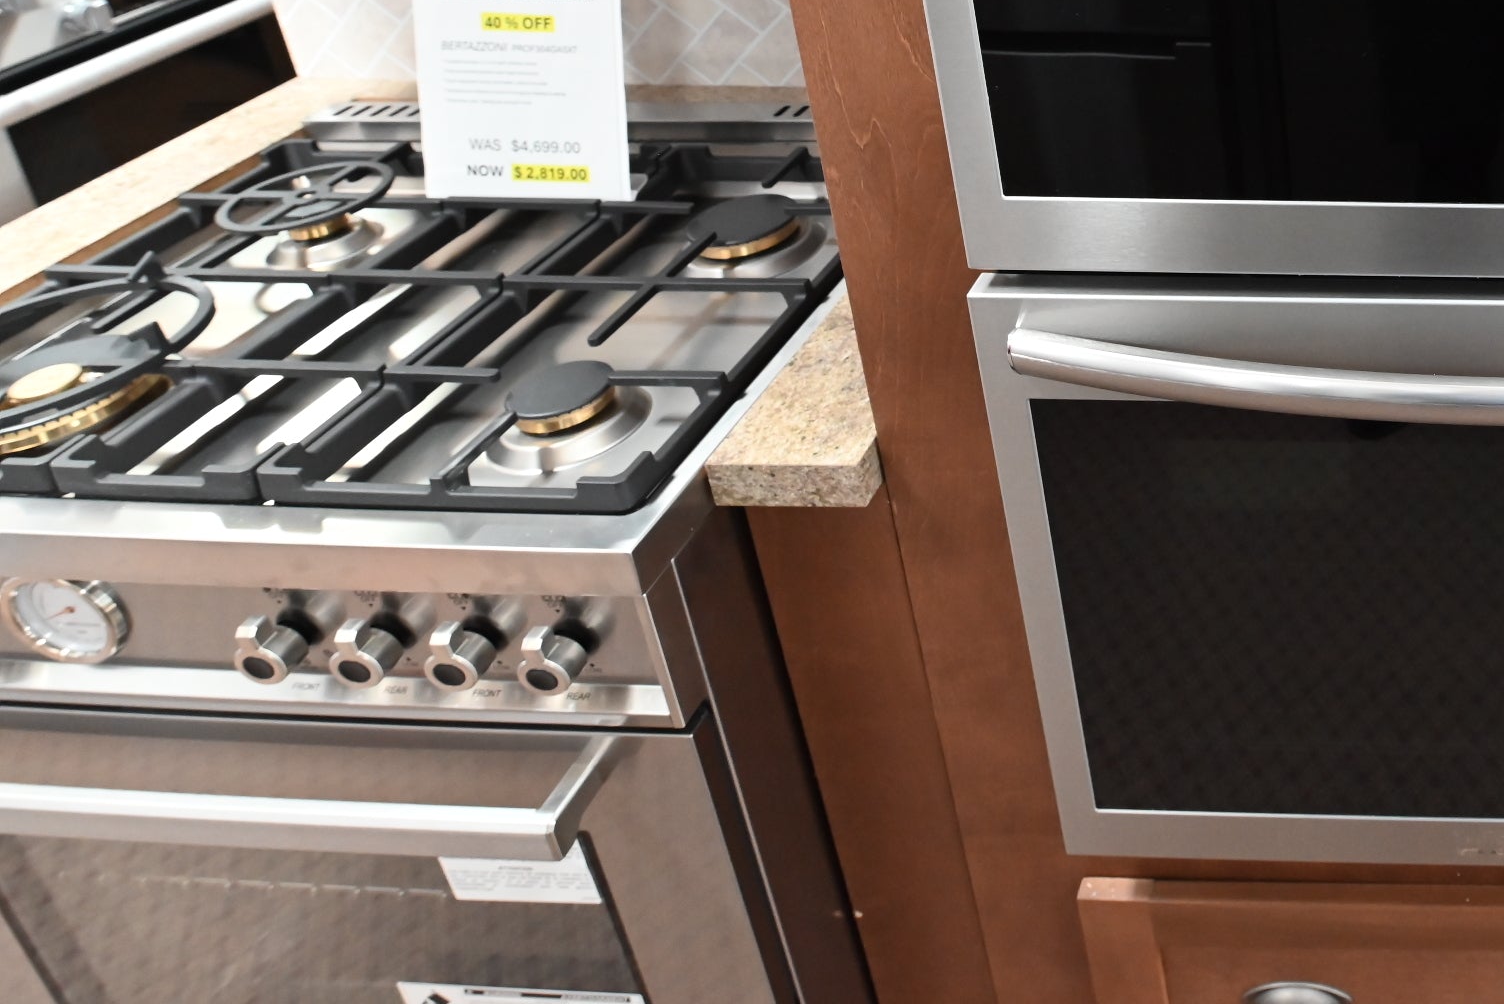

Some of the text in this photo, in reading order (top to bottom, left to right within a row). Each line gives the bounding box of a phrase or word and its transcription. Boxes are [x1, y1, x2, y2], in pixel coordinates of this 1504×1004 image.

[484, 16, 552, 30] 40 % OFF
[469, 139, 581, 155] WAS $4,699.00
[467, 164, 504, 178] NOW
[291, 682, 320, 691] FRONT
[384, 685, 409, 695] REAR
[472, 689, 502, 698] FRONT
[566, 692, 592, 701] REAR
